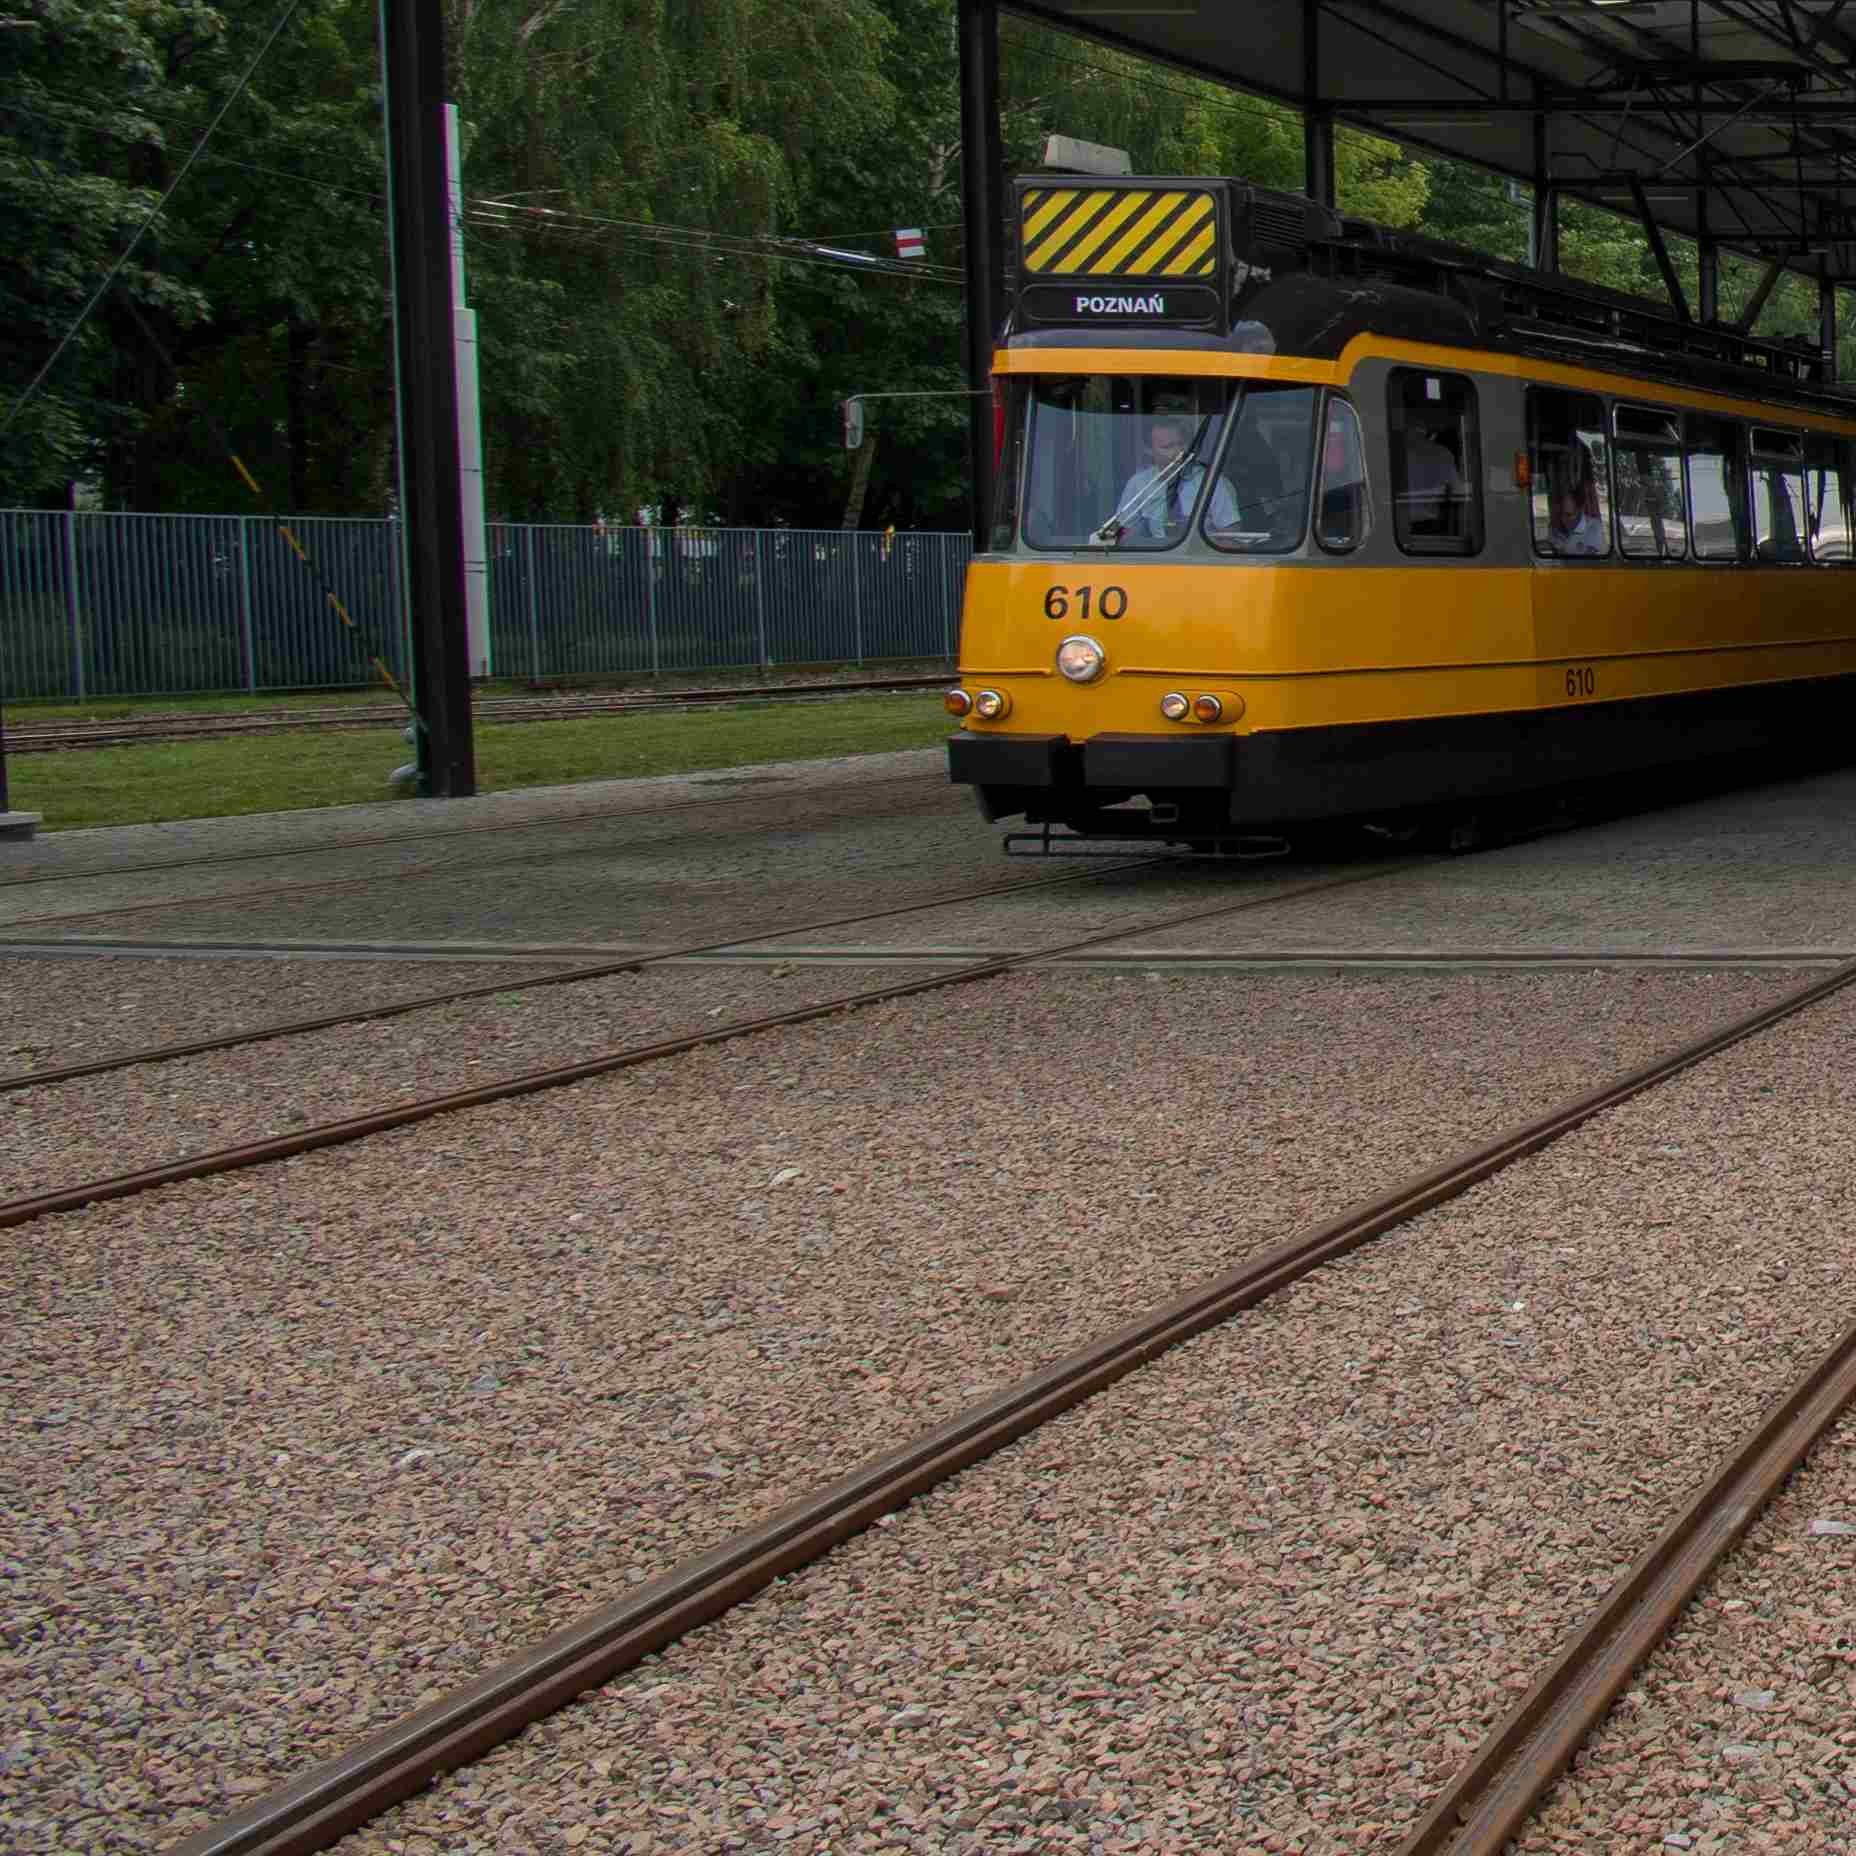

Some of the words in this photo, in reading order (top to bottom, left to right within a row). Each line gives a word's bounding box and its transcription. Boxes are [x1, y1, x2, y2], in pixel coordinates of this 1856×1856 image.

[1076, 293, 1164, 313] POZNAŃ
[1043, 584, 1129, 621] 610
[1565, 666, 1594, 697] 610
